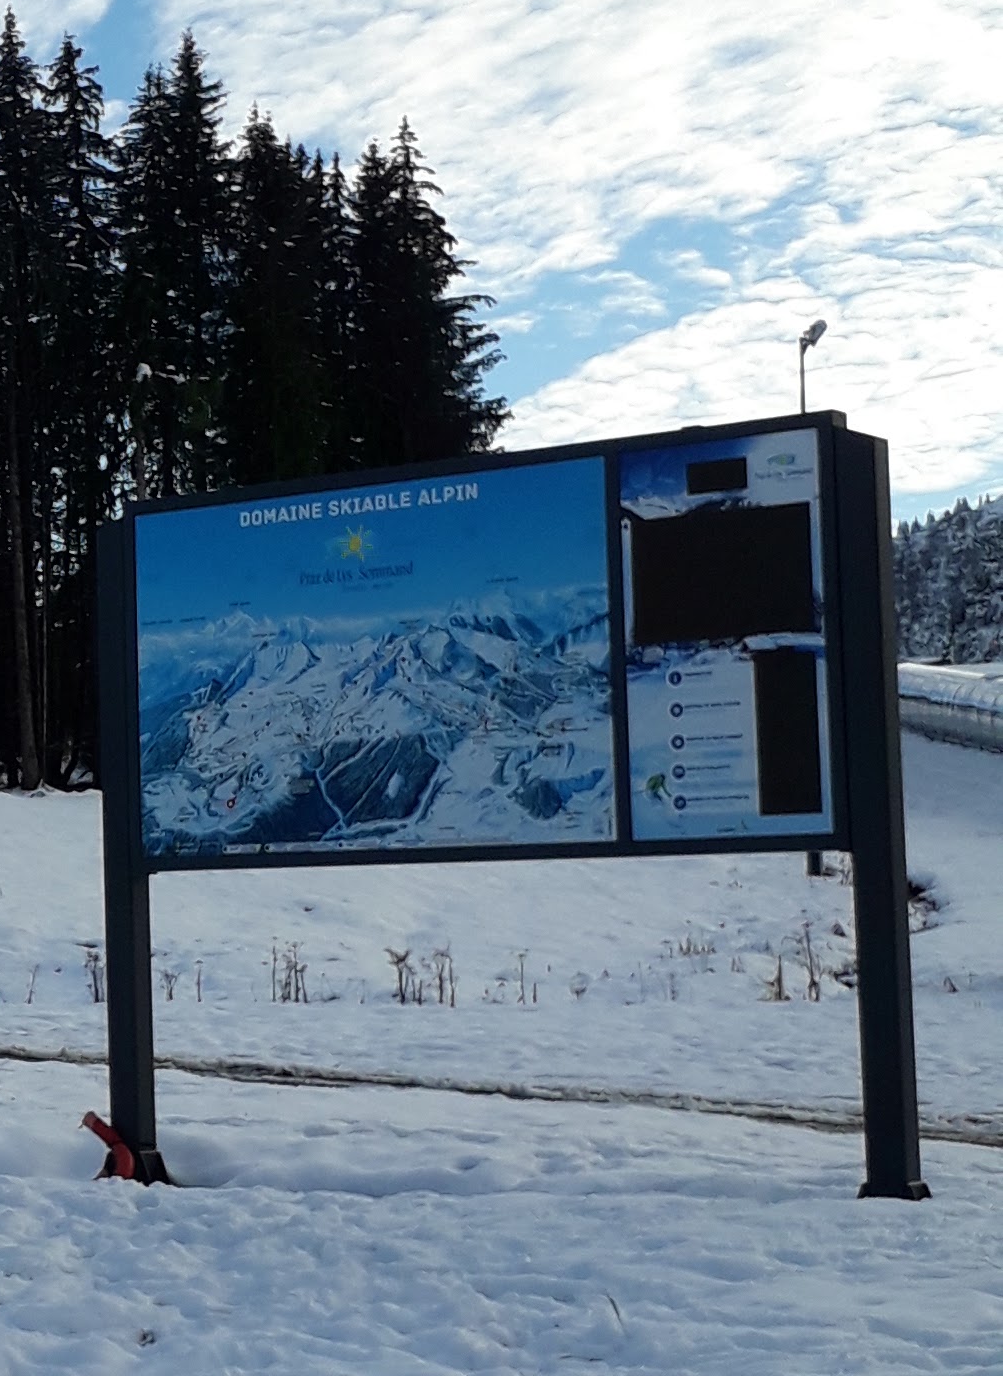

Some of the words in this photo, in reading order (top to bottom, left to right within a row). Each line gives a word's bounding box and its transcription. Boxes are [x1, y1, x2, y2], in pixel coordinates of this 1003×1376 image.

[239, 502, 322, 527] DOMAINE
[328, 492, 412, 517] SKIABLE
[417, 483, 479, 506] ALPIN
